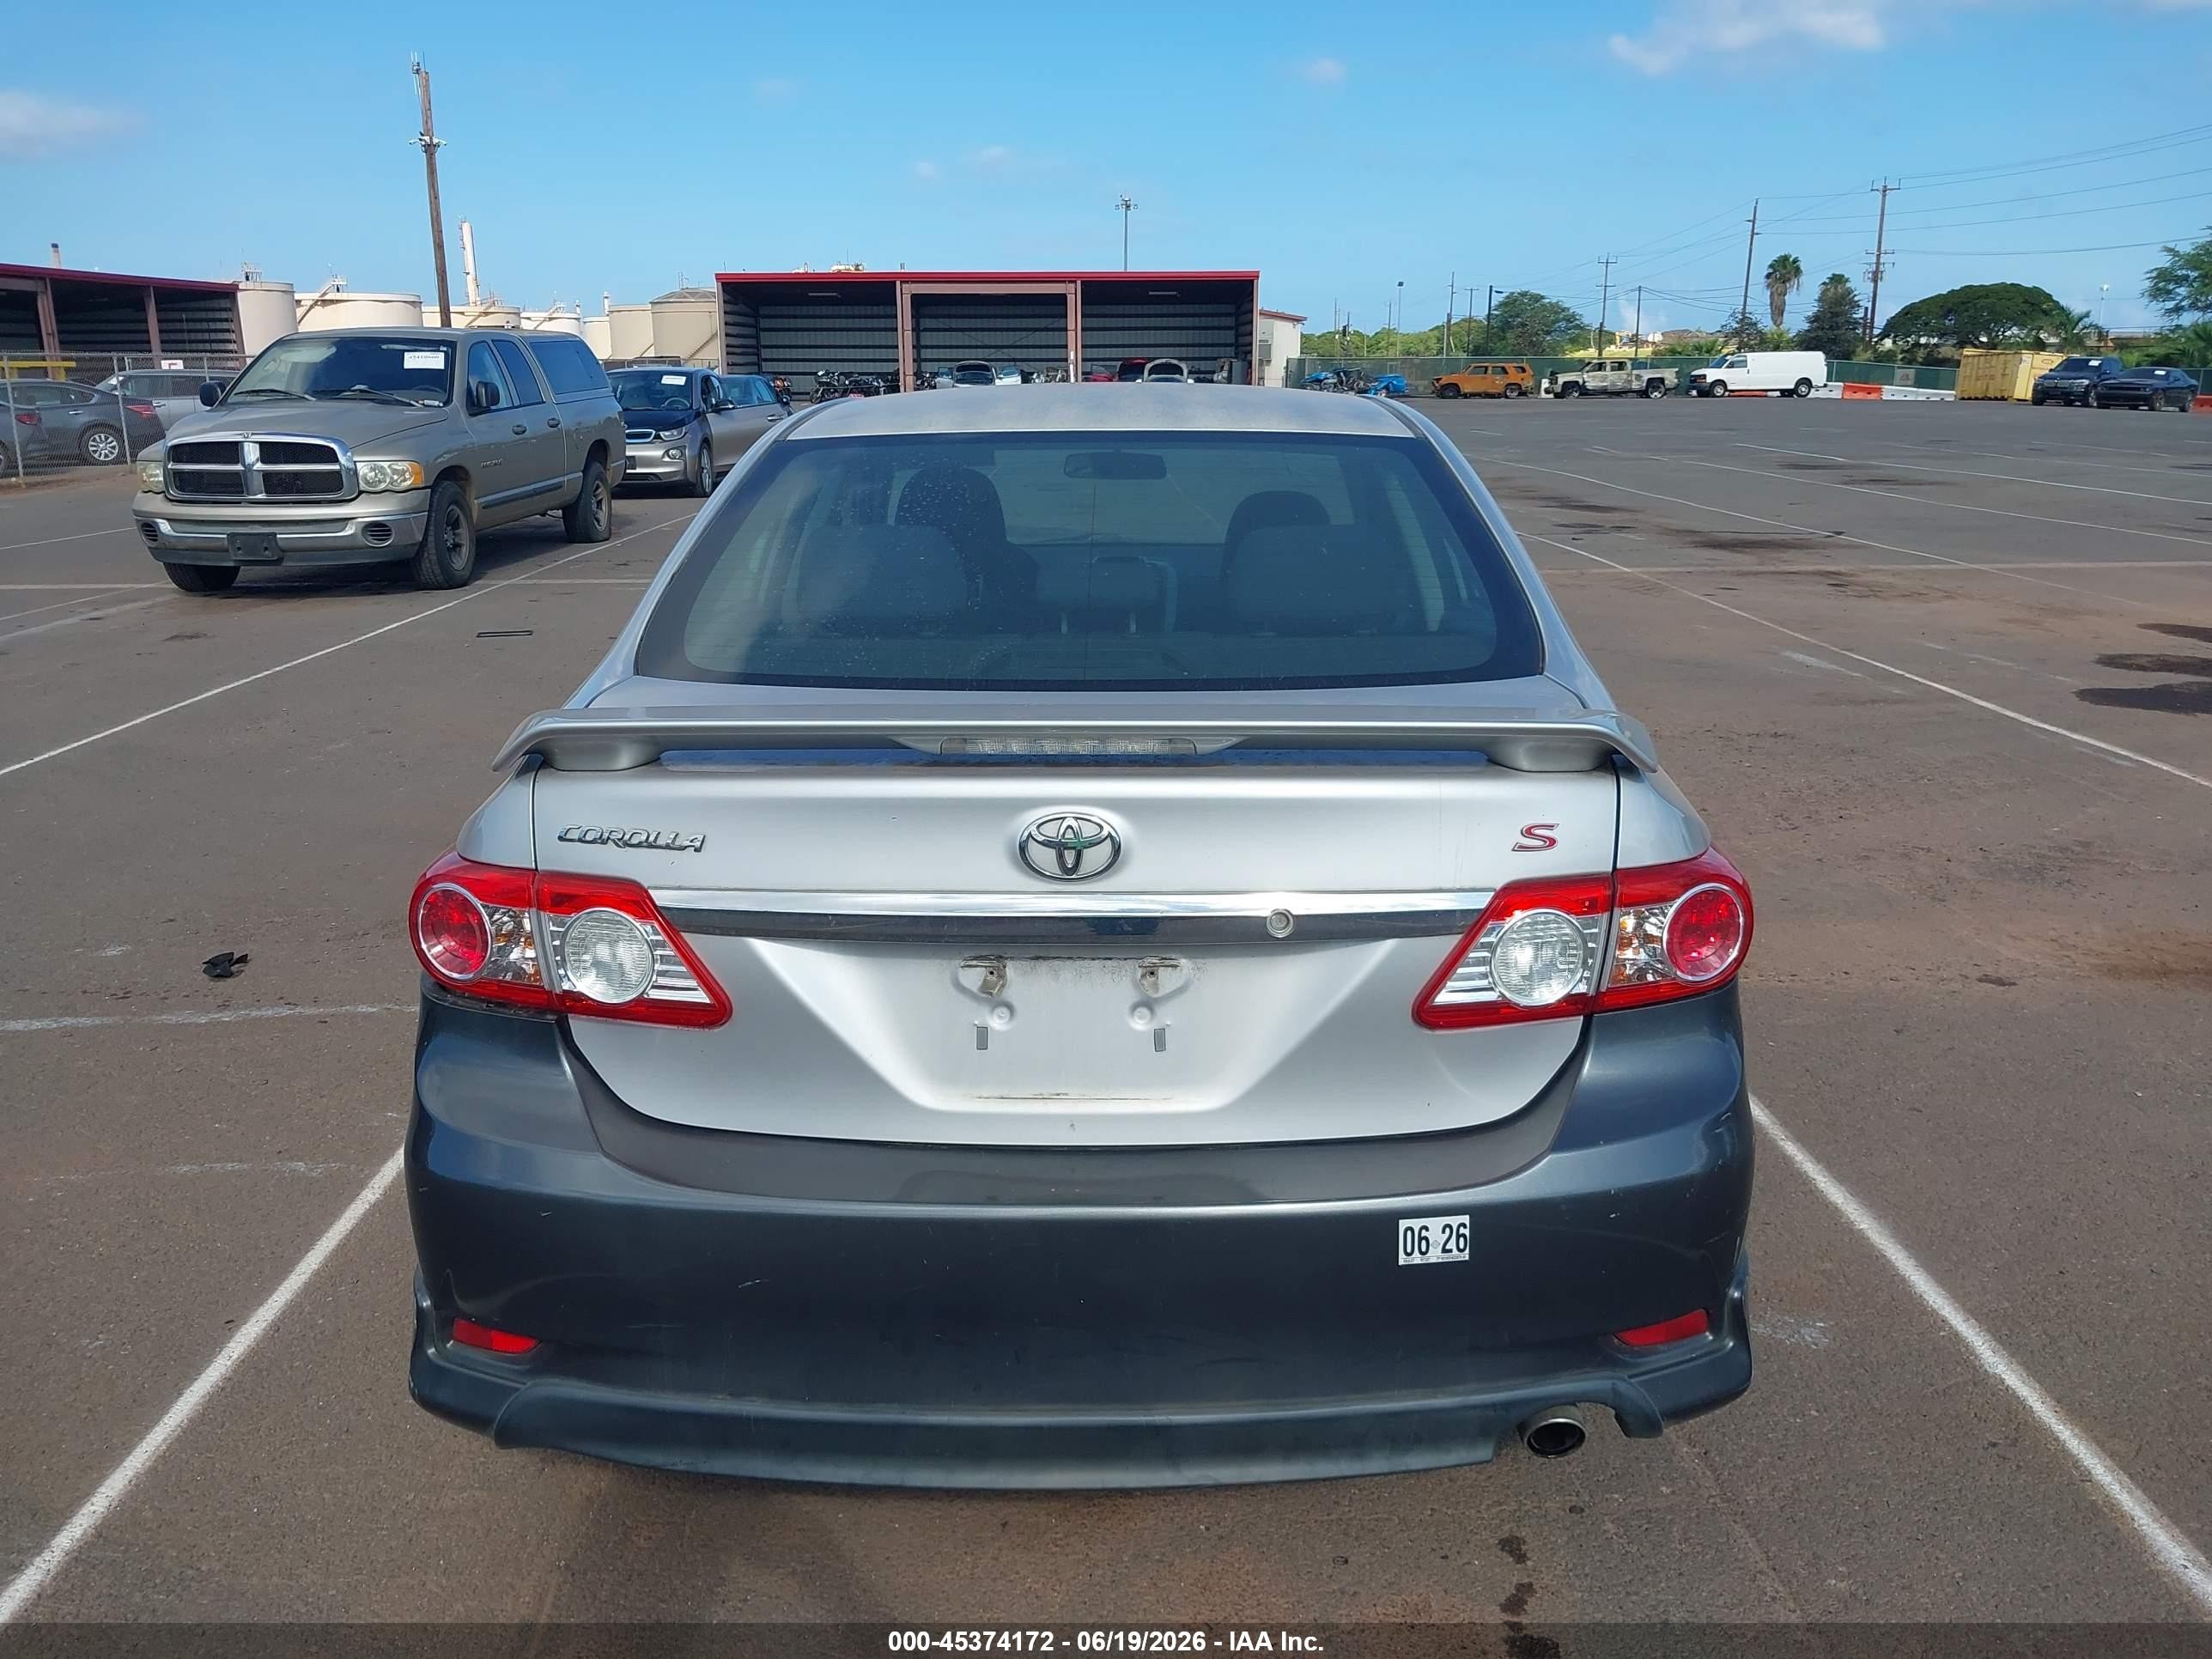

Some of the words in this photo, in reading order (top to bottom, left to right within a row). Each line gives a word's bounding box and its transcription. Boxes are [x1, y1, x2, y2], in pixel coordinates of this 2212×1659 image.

[557, 824, 706, 853] COROLLA
[1511, 823, 1559, 852] S
[1402, 1225, 1431, 1257] 06
[1441, 1222, 1468, 1254] 26
